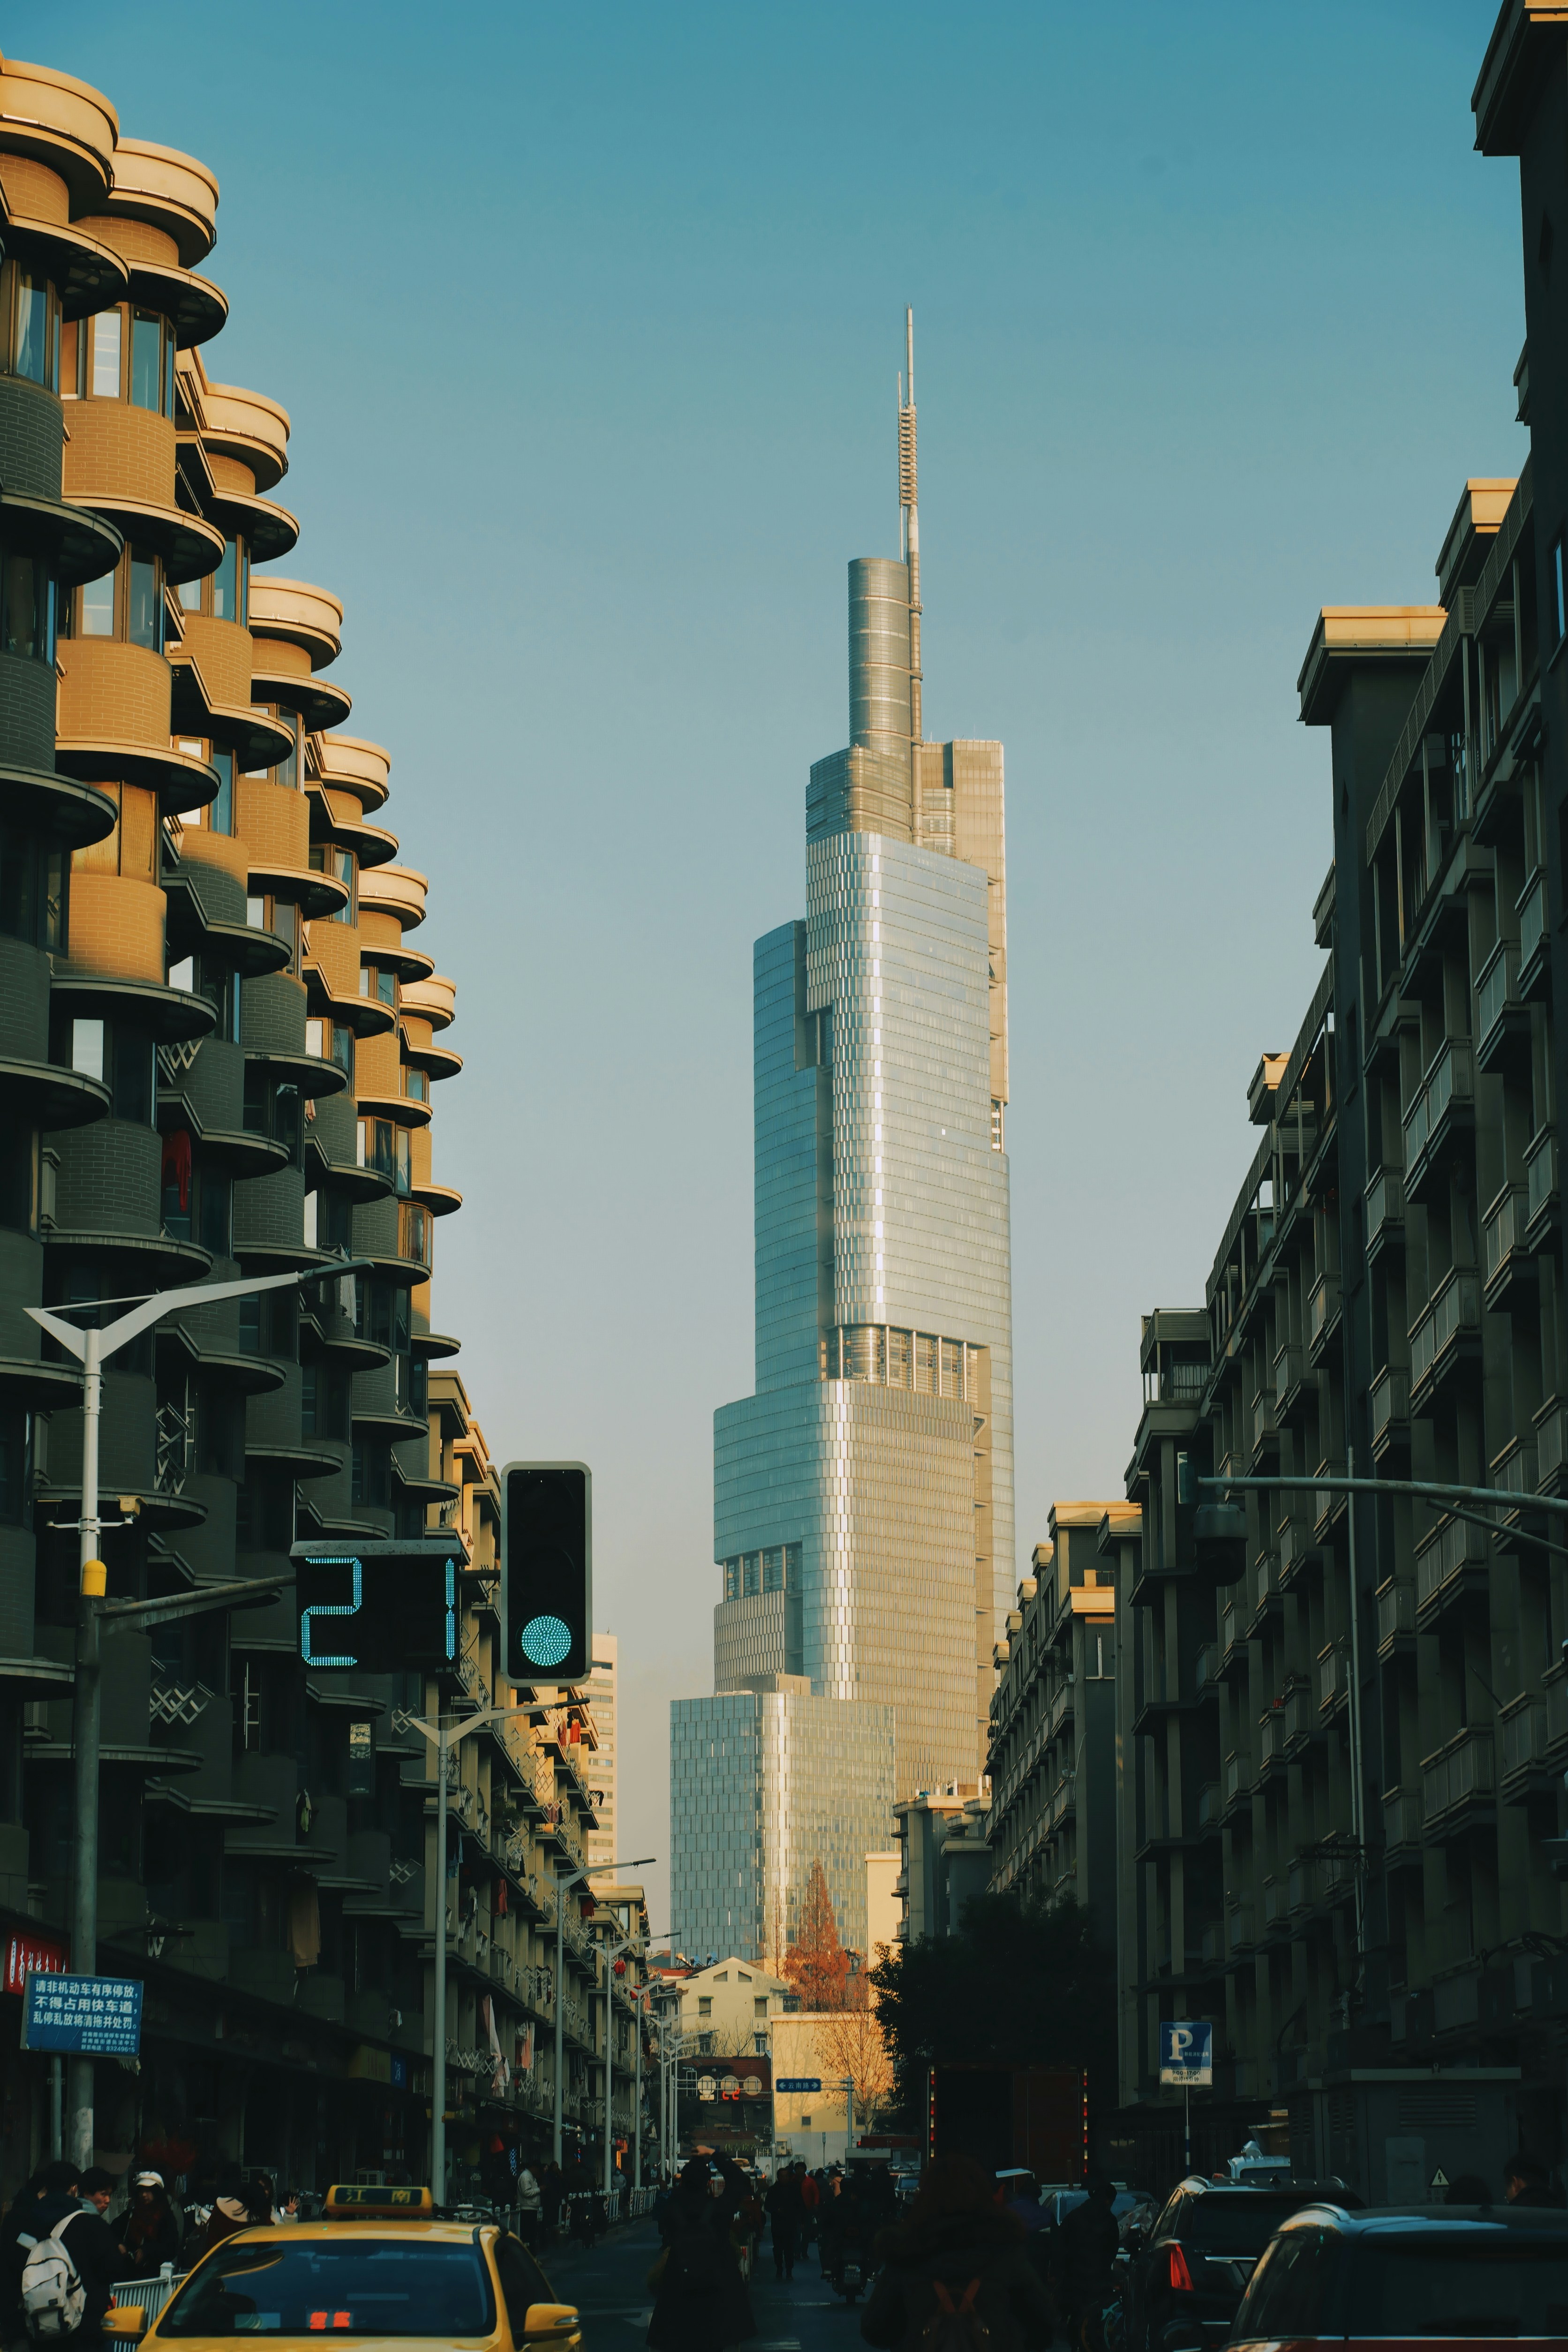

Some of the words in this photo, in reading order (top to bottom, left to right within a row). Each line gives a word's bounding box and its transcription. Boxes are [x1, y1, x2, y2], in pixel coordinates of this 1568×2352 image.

[301, 1556, 456, 1667] 21
[1168, 2029, 1193, 2060] P
[346, 2188, 412, 2204] 江南
